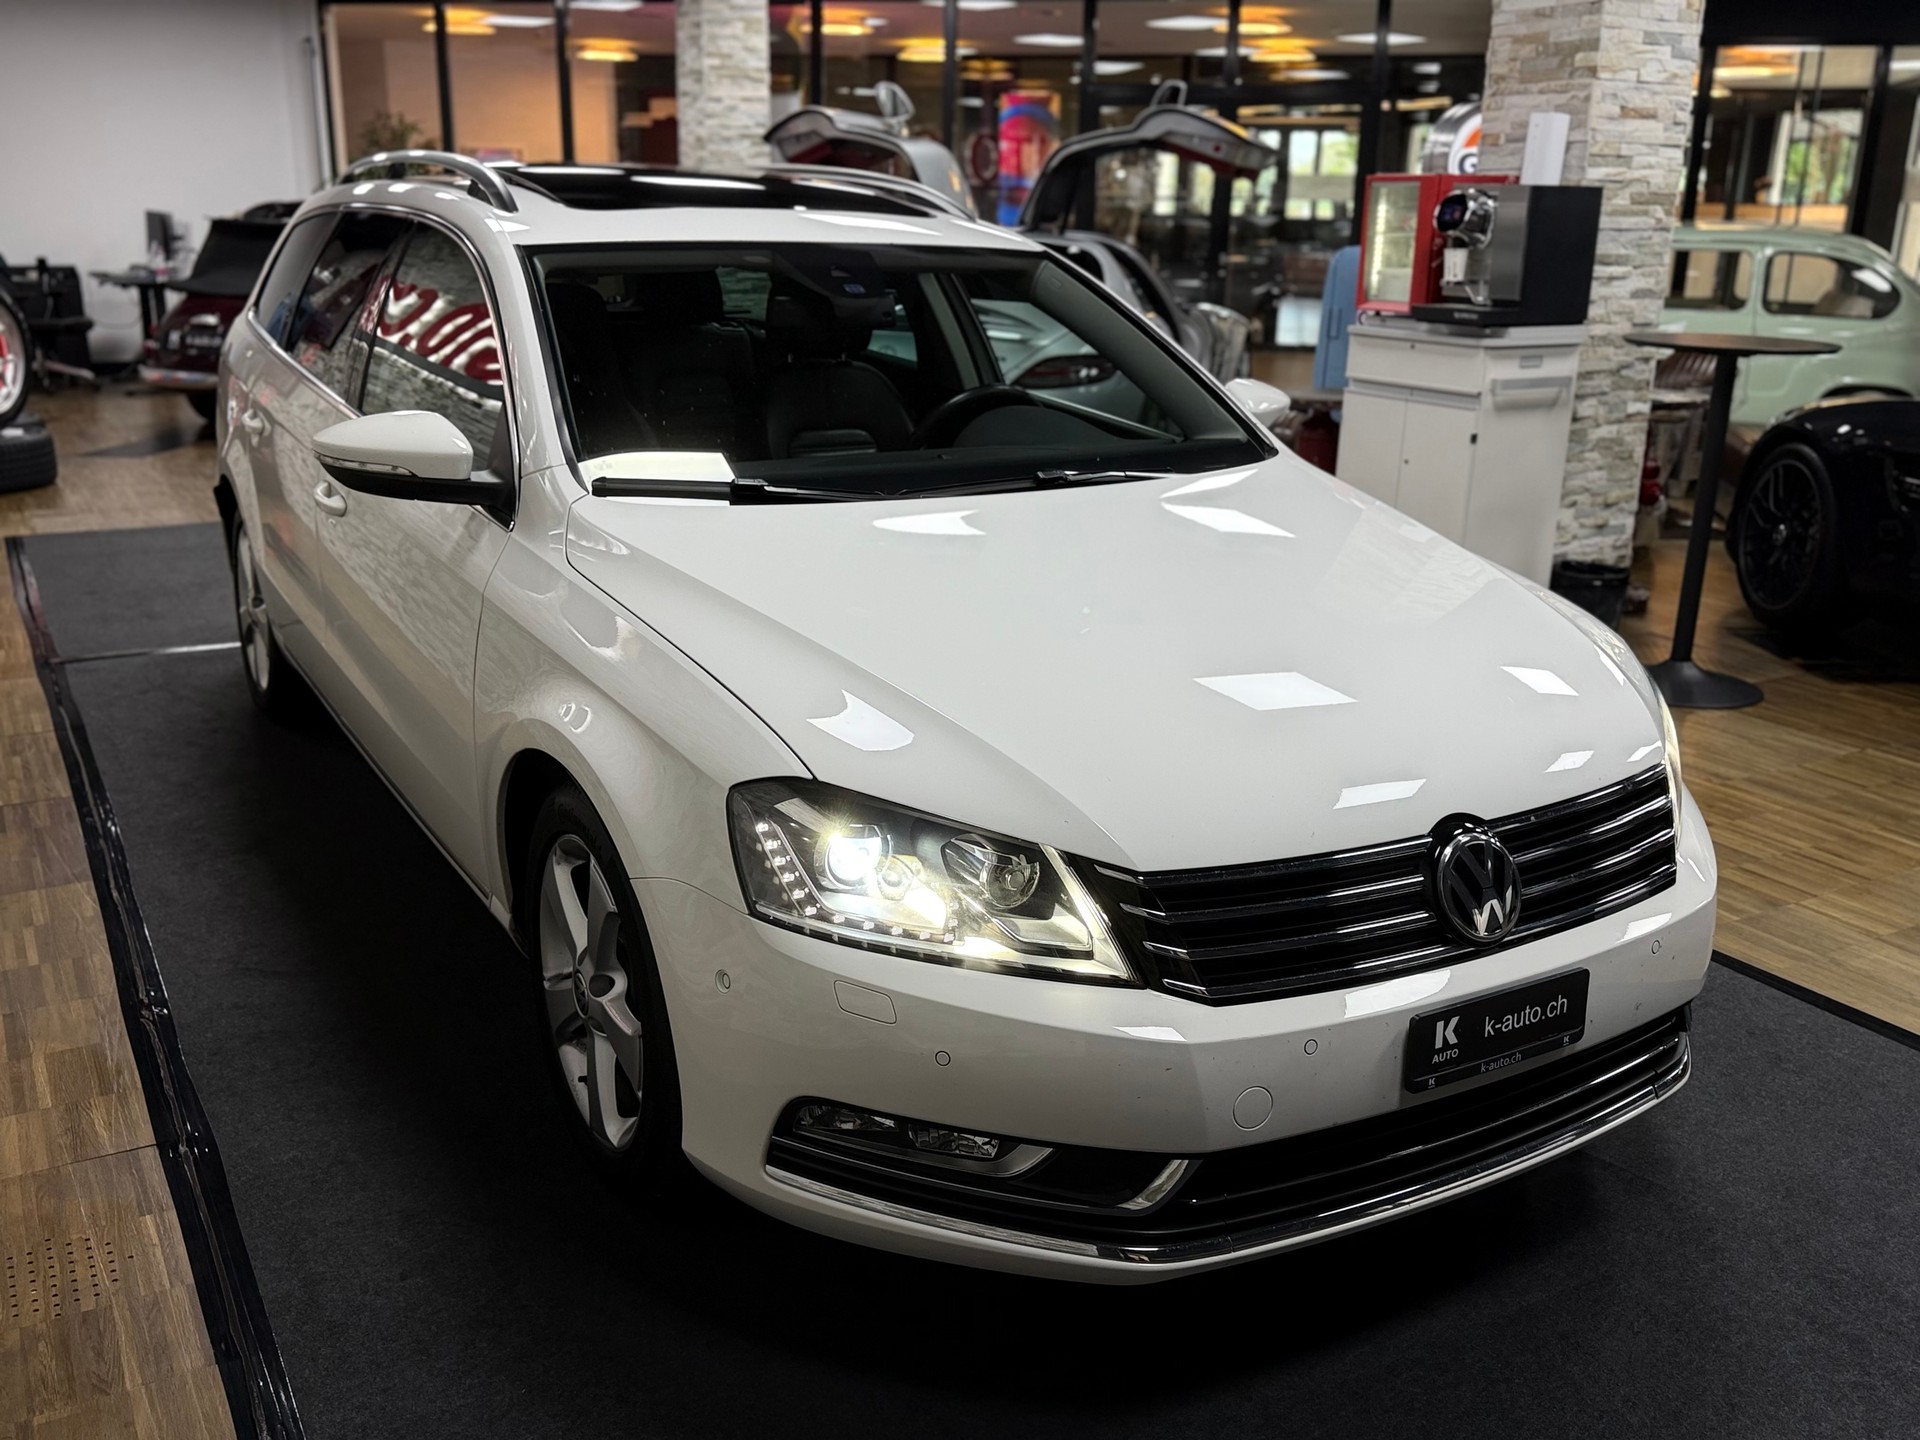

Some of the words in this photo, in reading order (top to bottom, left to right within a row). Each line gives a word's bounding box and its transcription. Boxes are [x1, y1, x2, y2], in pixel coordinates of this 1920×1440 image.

[1484, 994, 1568, 1038] k-auto.ch
[1434, 1015, 1460, 1049] K
[1431, 1048, 1459, 1064] AUTO
[1480, 1051, 1522, 1073] k-auto.ch
